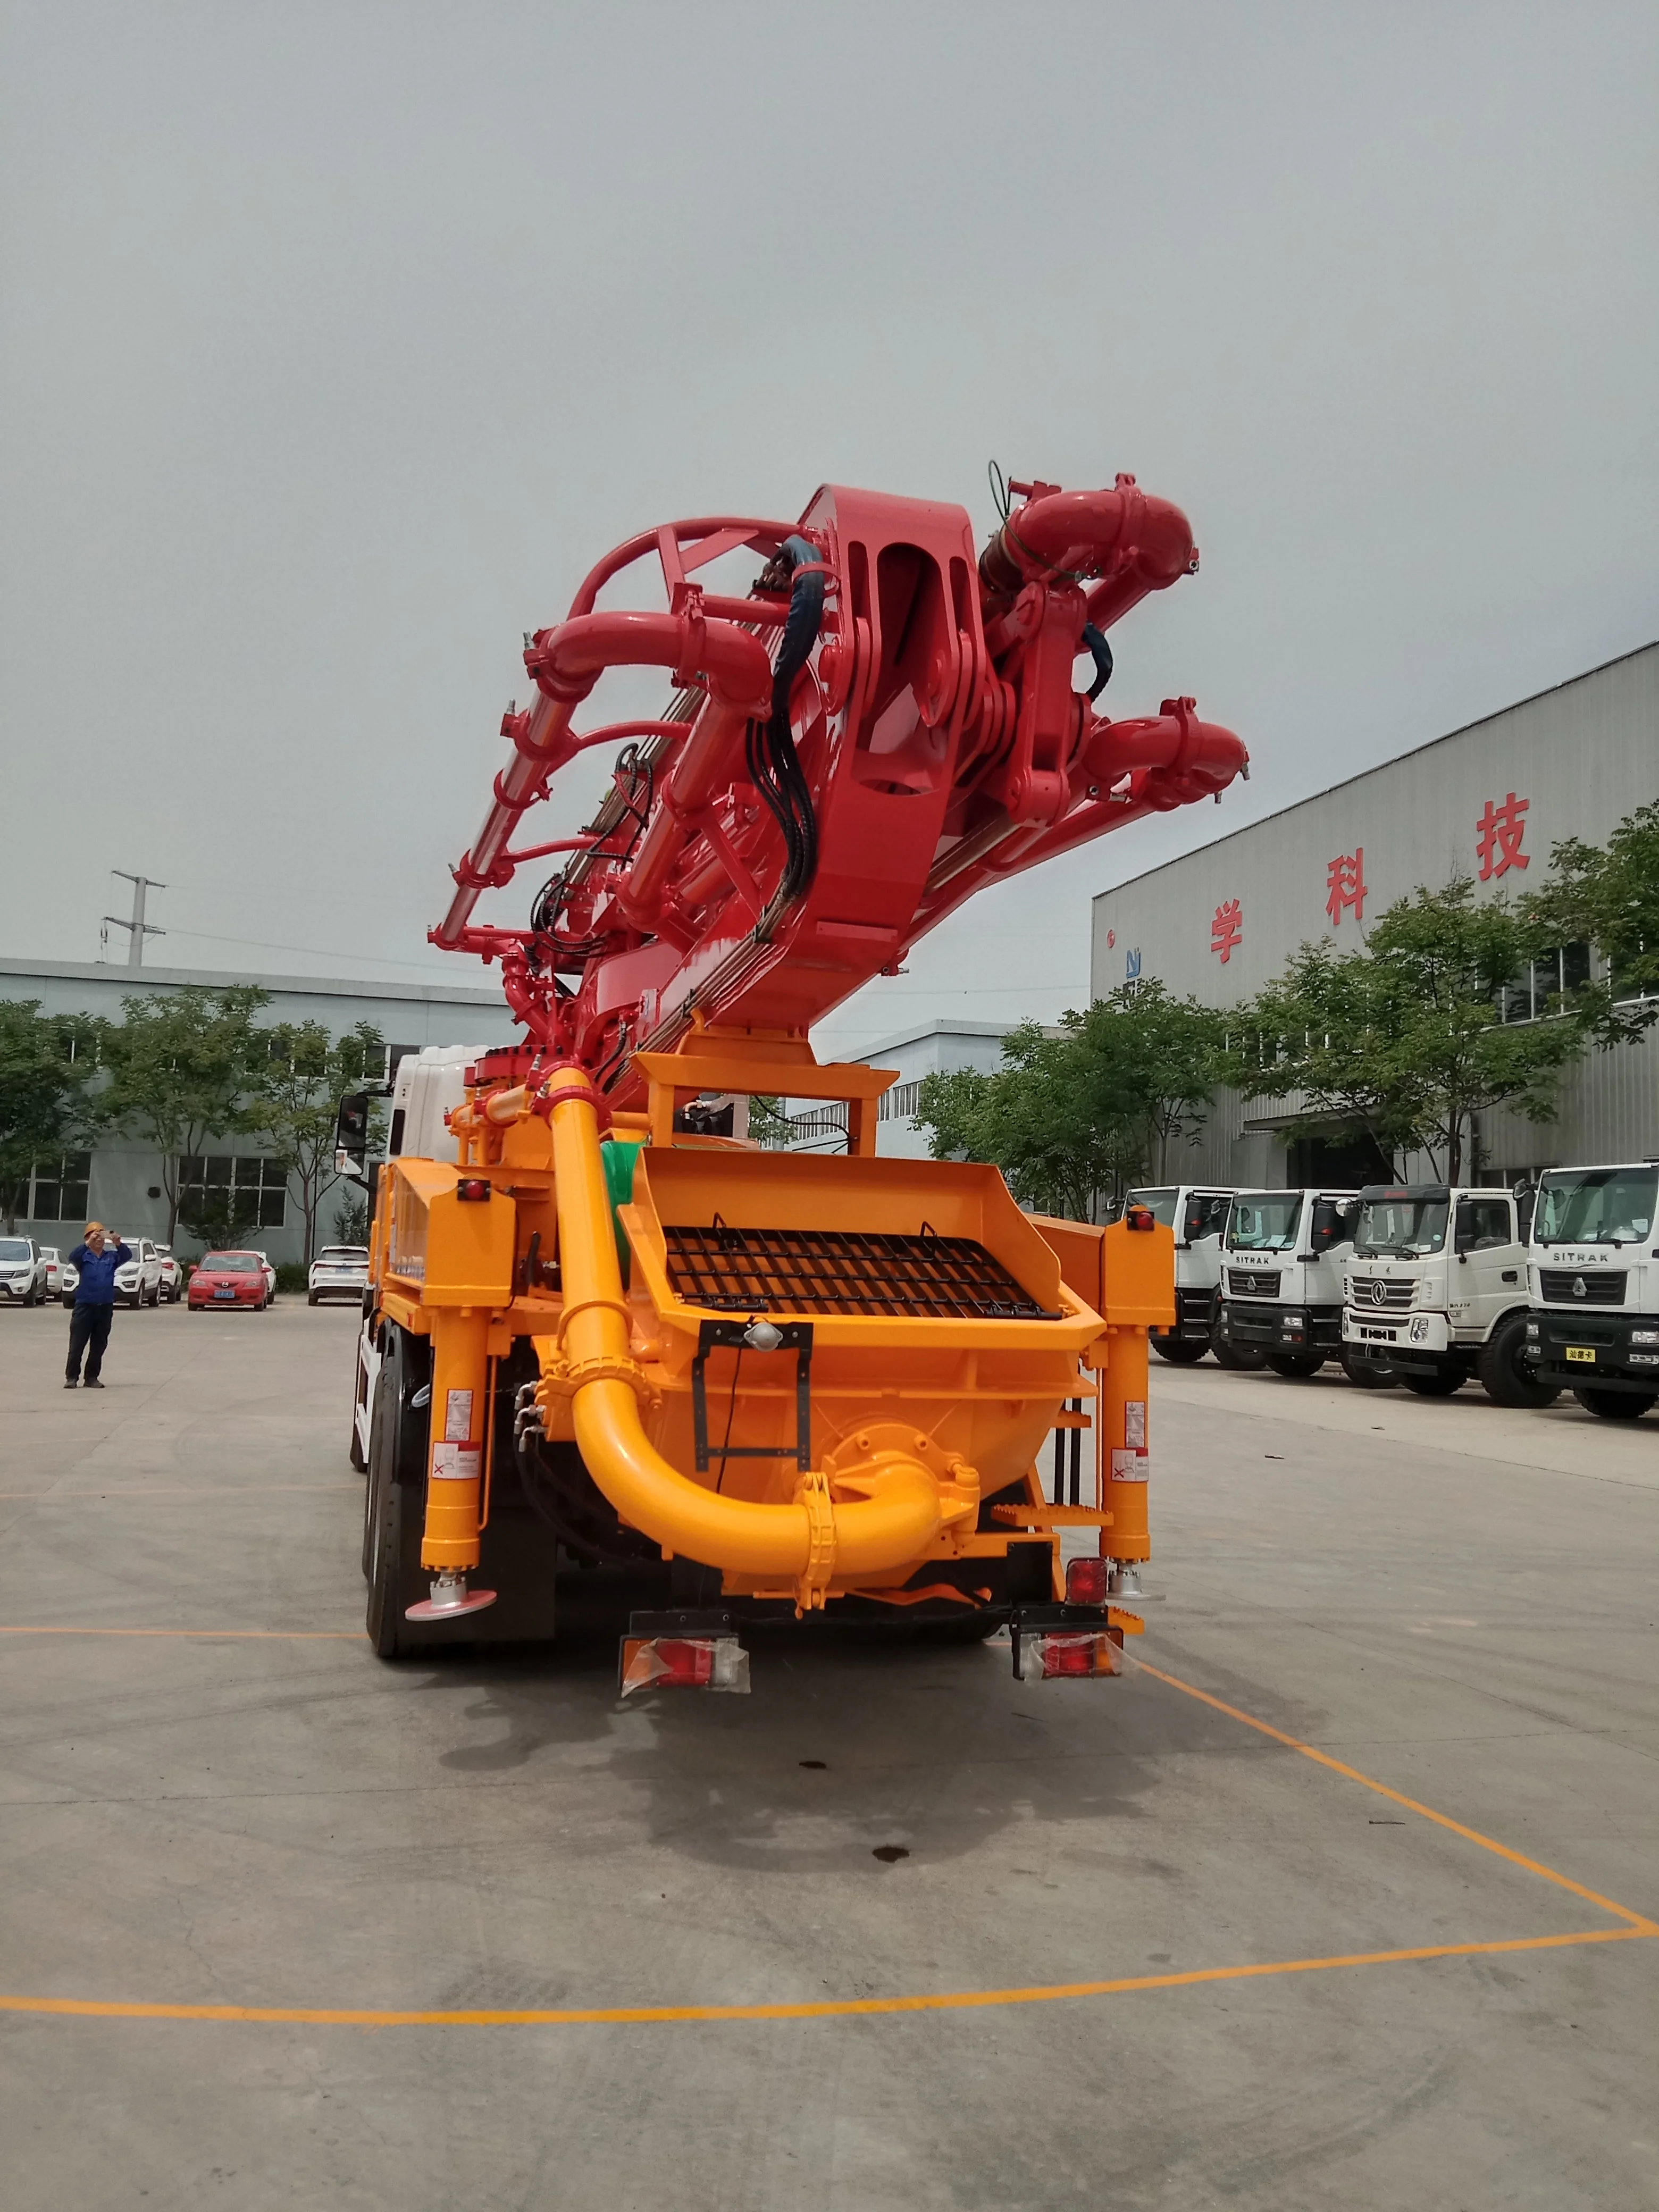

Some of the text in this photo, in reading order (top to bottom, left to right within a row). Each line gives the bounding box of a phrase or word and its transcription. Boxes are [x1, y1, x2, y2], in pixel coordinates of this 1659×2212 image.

[1554, 1252, 1608, 1262] SITRAK
[1569, 1350, 1593, 1360] 汕德卡
